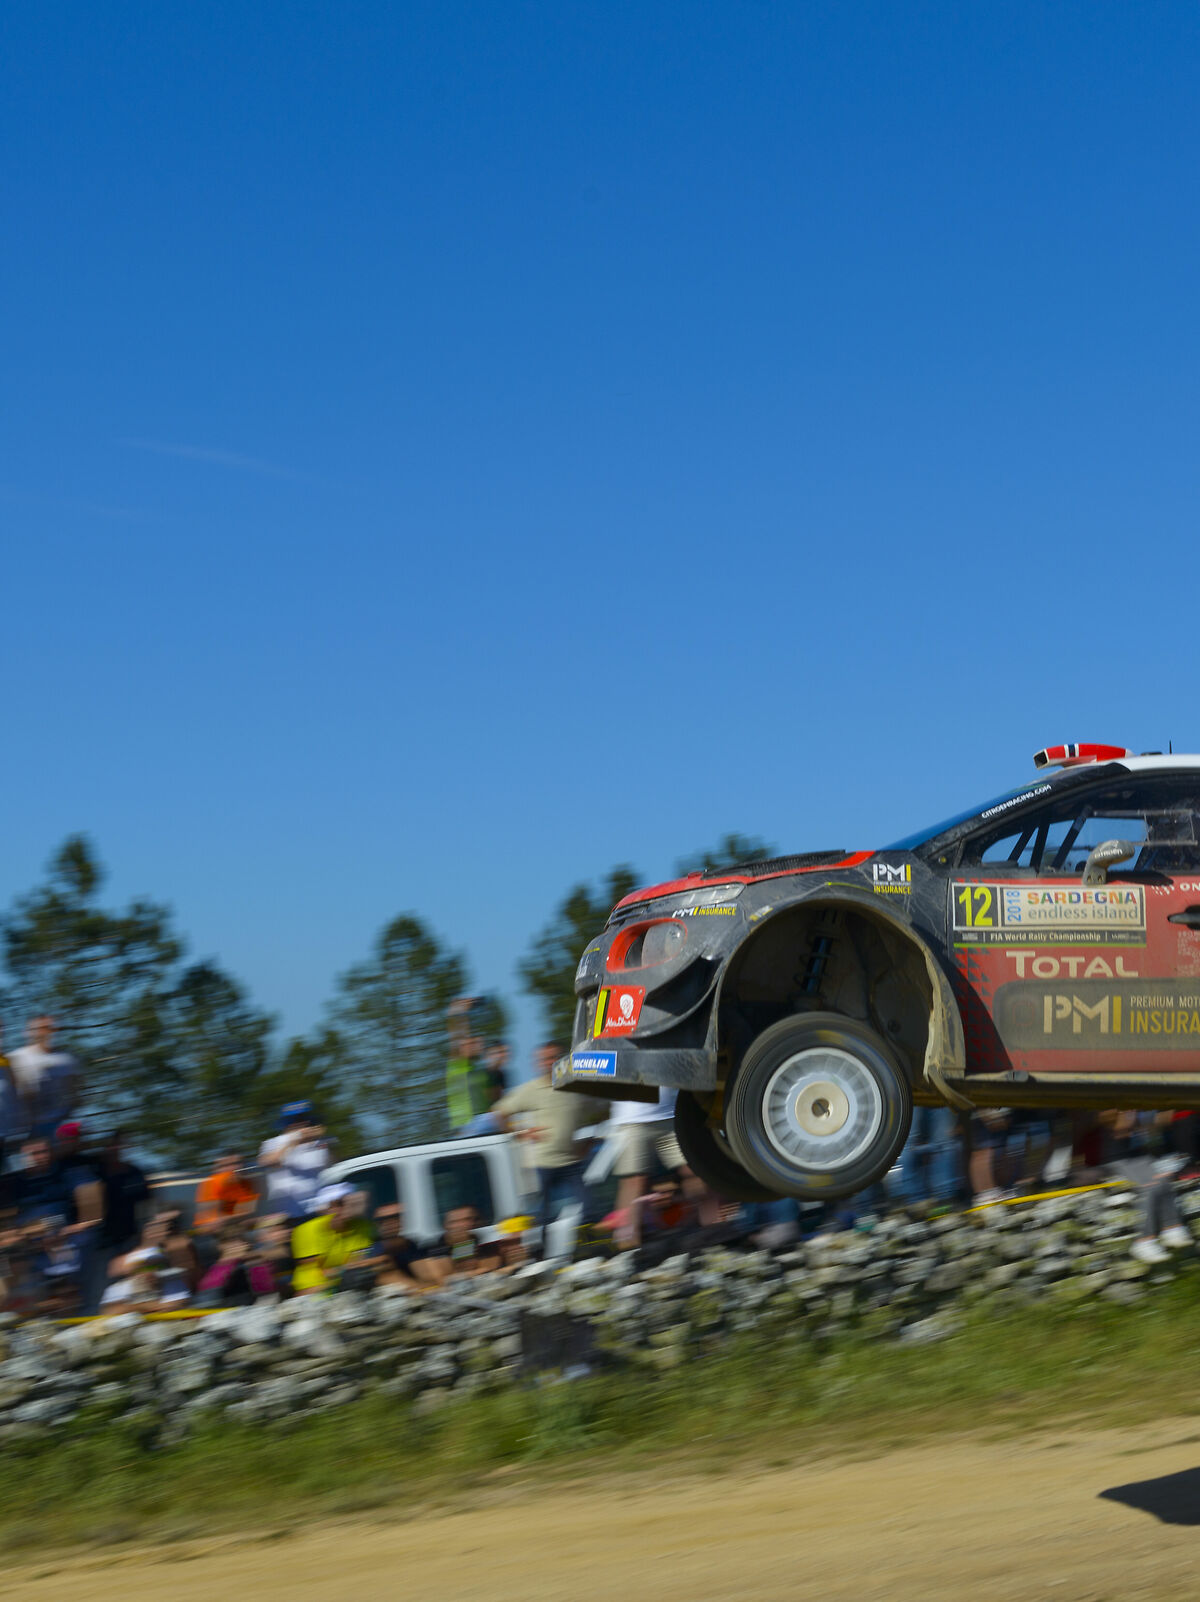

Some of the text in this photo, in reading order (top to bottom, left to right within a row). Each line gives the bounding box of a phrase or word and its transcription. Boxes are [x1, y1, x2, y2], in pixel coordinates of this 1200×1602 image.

[872, 863, 912, 882] PMI
[873, 884, 912, 895] INSURANCE
[1027, 891, 1137, 905] SARDEGNA
[672, 906, 699, 919] PMI
[698, 906, 737, 917] INSURANCE
[959, 887, 993, 926] 12
[1006, 890, 1023, 922] 2018
[1028, 904, 1138, 920] endless island
[990, 932, 1003, 942] FIA
[1005, 932, 1027, 942] World
[1029, 932, 1047, 943] Rally
[1049, 932, 1101, 943] Championship
[1006, 951, 1139, 978] TOTAL
[1130, 996, 1174, 1009] PREMIUM
[1043, 995, 1122, 1034] PMI
